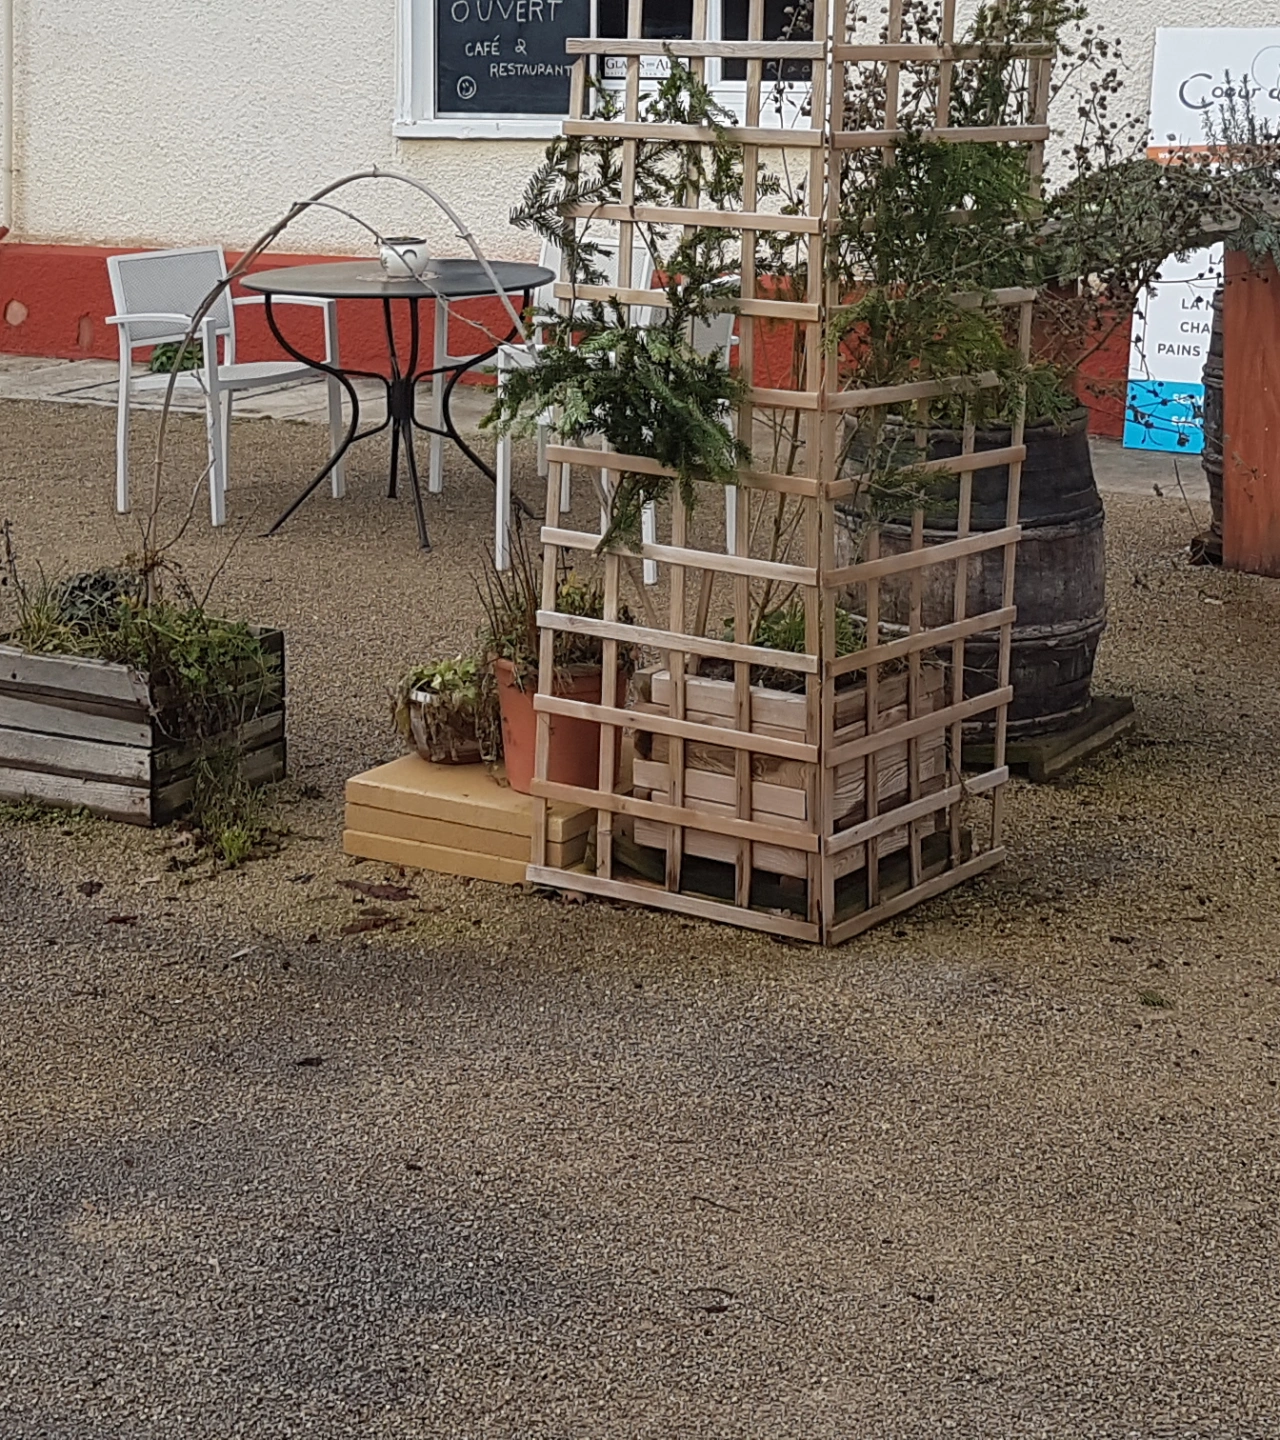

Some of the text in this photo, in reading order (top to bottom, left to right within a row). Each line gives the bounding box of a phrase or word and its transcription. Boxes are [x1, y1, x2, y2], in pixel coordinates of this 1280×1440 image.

[451, 0, 563, 23] OUVERT
[465, 34, 528, 57] CAFÉ &
[489, 63, 573, 78] RESTAURANT
[605, 57, 645, 70] GLAS
[1157, 343, 1201, 357] PAINS
